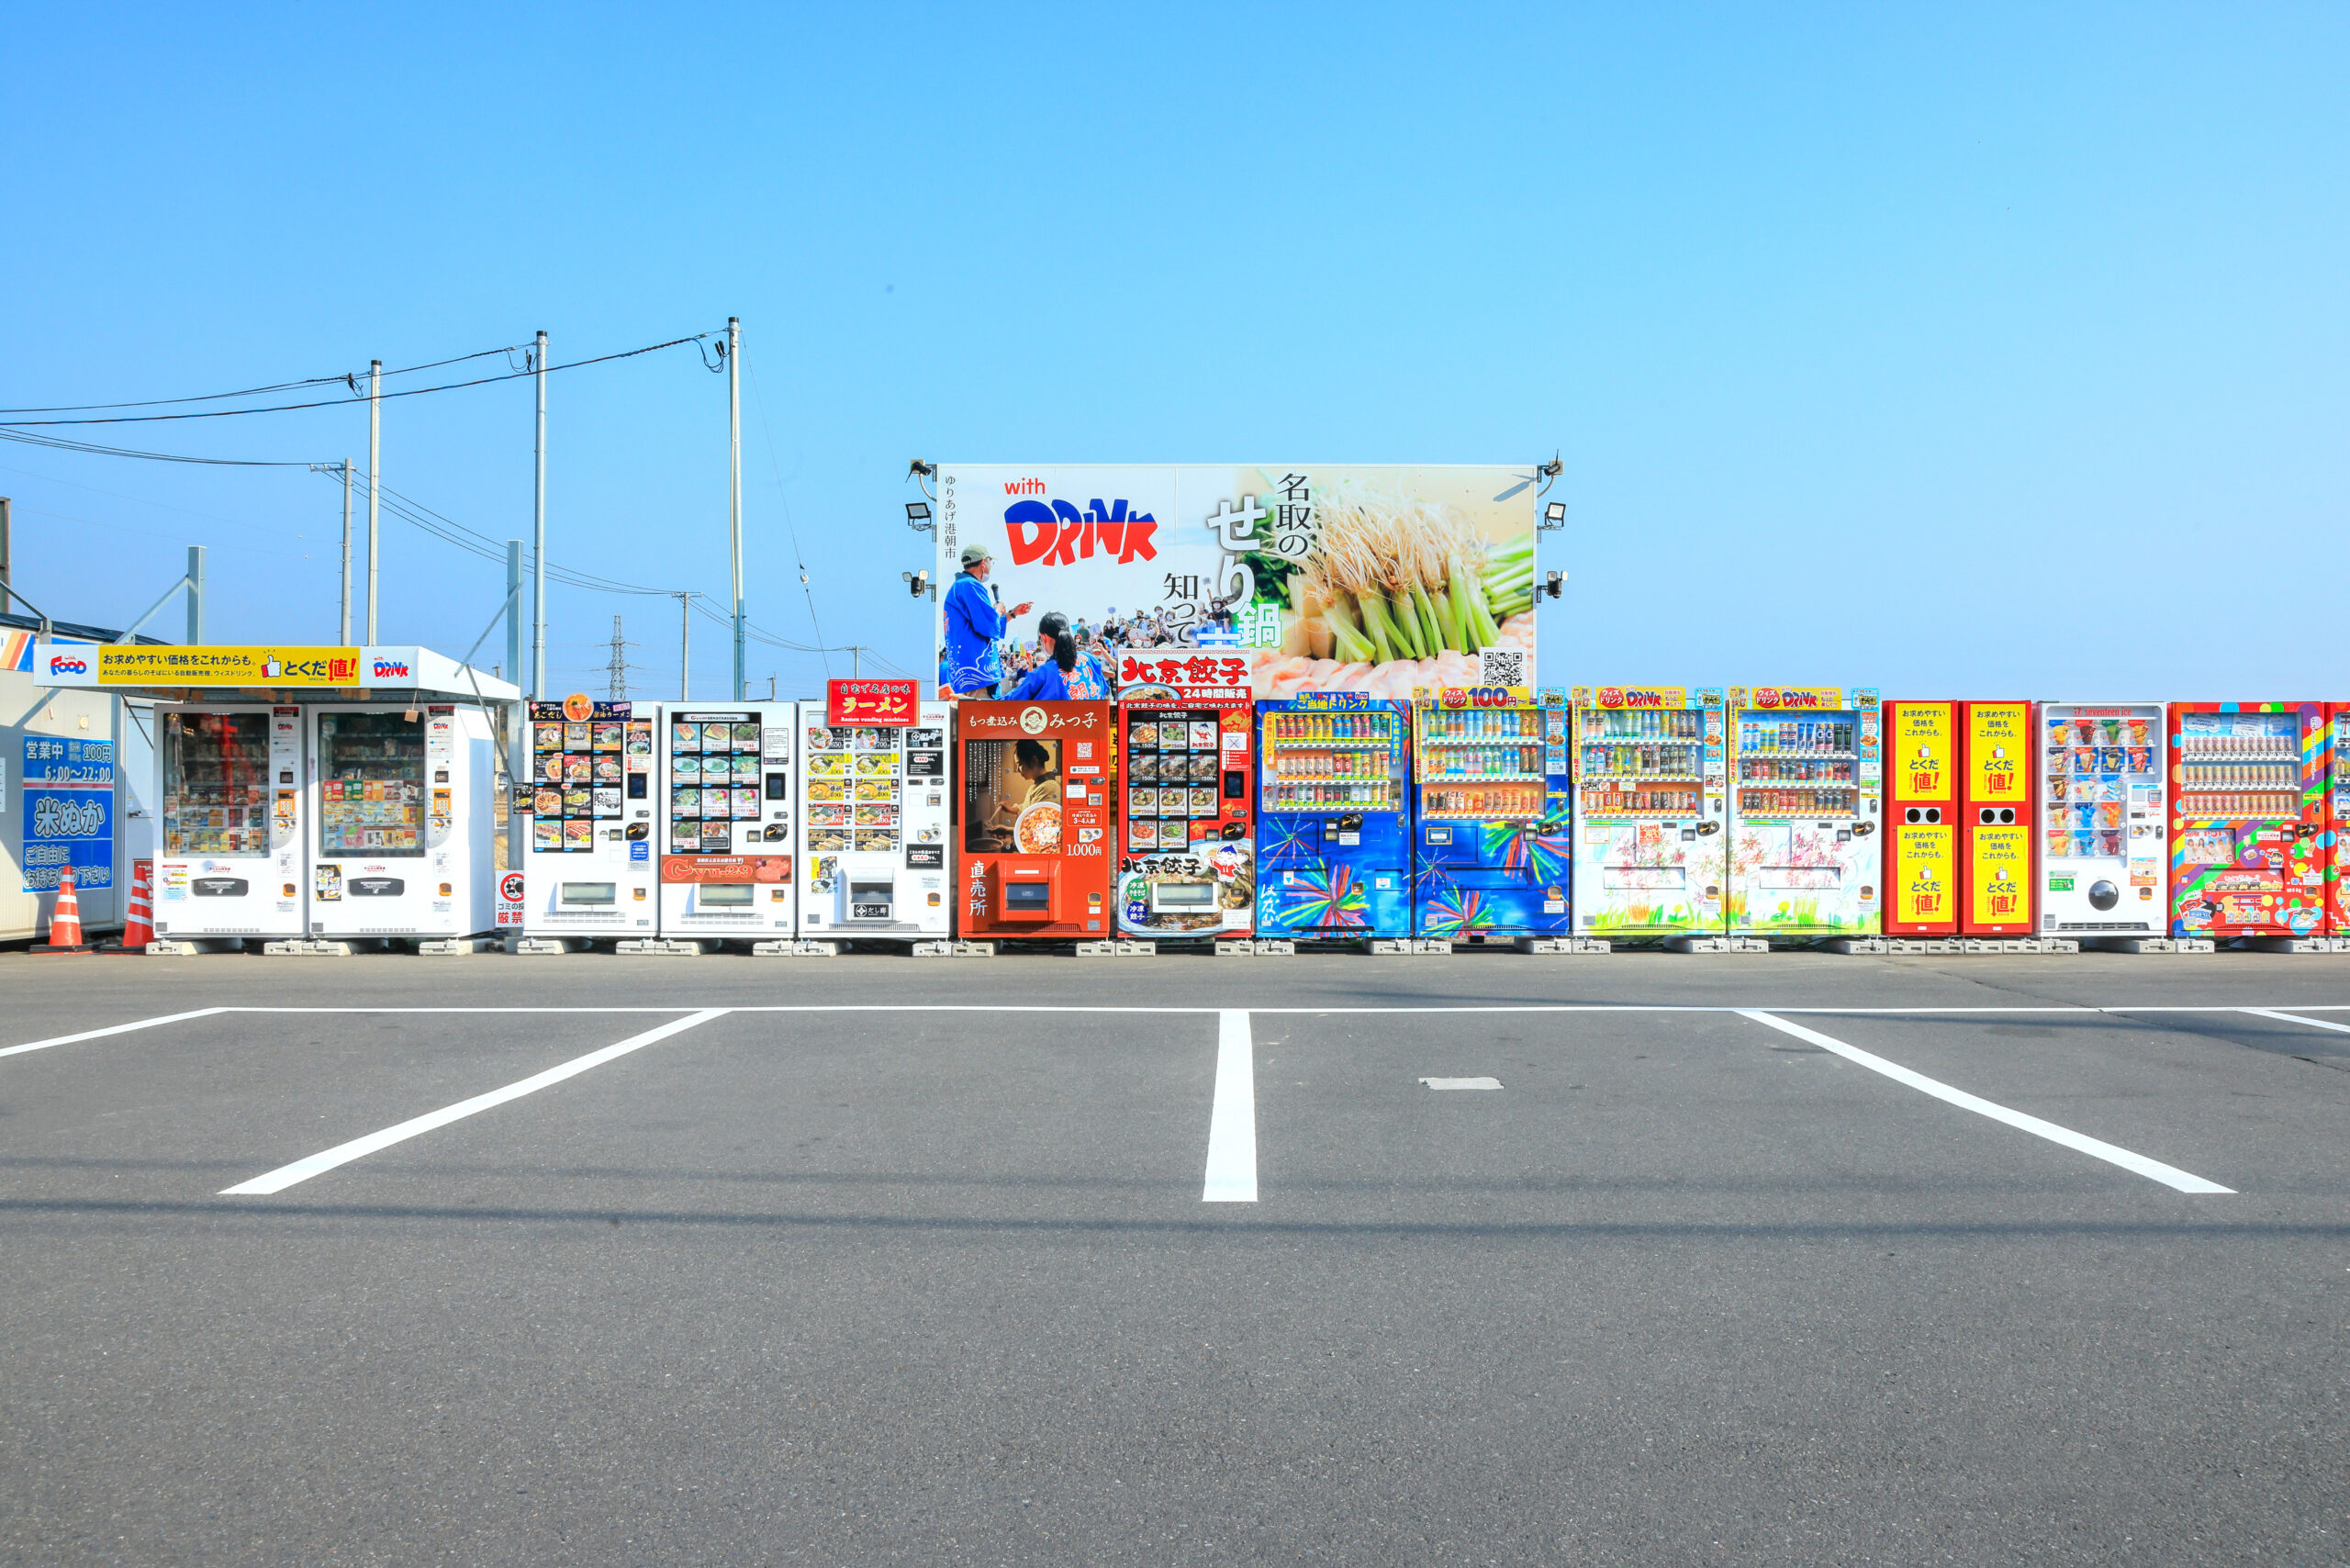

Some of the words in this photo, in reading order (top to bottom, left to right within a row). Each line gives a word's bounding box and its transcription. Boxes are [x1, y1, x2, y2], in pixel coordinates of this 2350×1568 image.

[1004, 477, 1046, 495] with
[944, 476, 957, 559] ゆりあげ港朝市
[1276, 473, 1312, 556] 名取の
[1003, 498, 1158, 566] DRINK
[1163, 572, 1199, 648] 知って
[50, 655, 87, 676] FOOD
[103, 654, 256, 666] お求めやすい価格をこれからも。
[373, 661, 408, 678] DRINK
[1121, 655, 1248, 685] 北京餃子
[841, 683, 911, 695] 自宅で名店の味
[1183, 688, 1248, 699] 24時間販売
[842, 697, 908, 714] ラーメン
[1297, 699, 1368, 710] ご当地ドリンク
[1626, 691, 1662, 707] DRINK
[1781, 691, 1818, 707] DRINK
[2085, 707, 2120, 716] seventeen
[2121, 706, 2132, 716] ice
[969, 715, 1018, 727] もつ煮込み
[1049, 712, 1098, 729] みつ子
[26, 741, 64, 760] 営業中
[84, 745, 112, 763] 100円
[1909, 759, 1939, 770] とくだ
[1984, 760, 2013, 771] とくだ
[34, 797, 105, 836] 米ぬか
[25, 845, 70, 865] ご自由に
[663, 858, 753, 881] Gyu-29
[1121, 857, 1202, 875] 北京餃子
[968, 859, 988, 917] 直売所
[1911, 881, 1941, 891] とくだ
[1986, 882, 2017, 892] とくだ
[498, 912, 523, 924] 厳禁
[1129, 913, 1146, 921] 餃子
